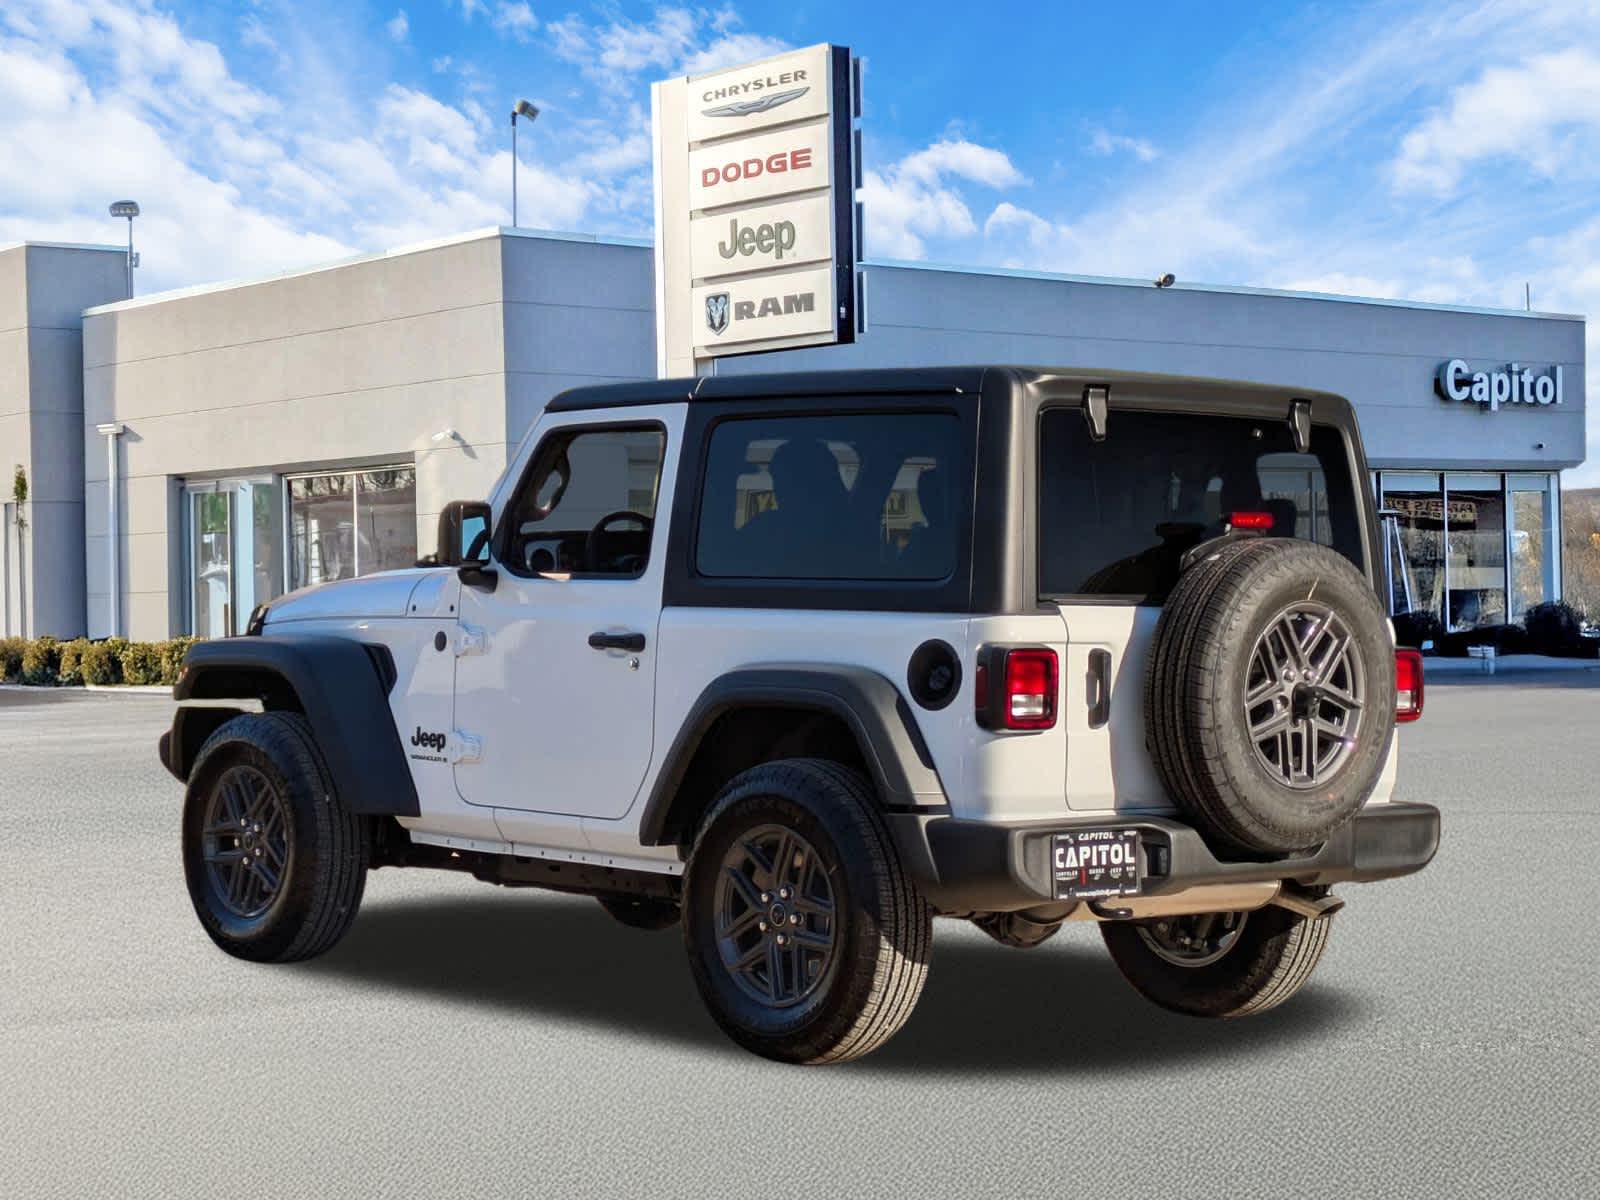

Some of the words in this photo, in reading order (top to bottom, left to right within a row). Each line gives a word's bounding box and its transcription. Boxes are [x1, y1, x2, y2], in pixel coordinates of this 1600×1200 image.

[702, 69, 808, 103] CHRYSLER
[702, 147, 812, 188] DODGE
[718, 218, 796, 260] Jeep
[734, 291, 815, 321] RAM
[1446, 358, 1563, 412] Capitol
[411, 725, 446, 753] Jeep
[1078, 831, 1114, 841] CAPITOL
[1055, 843, 1136, 868] CAPITOL
